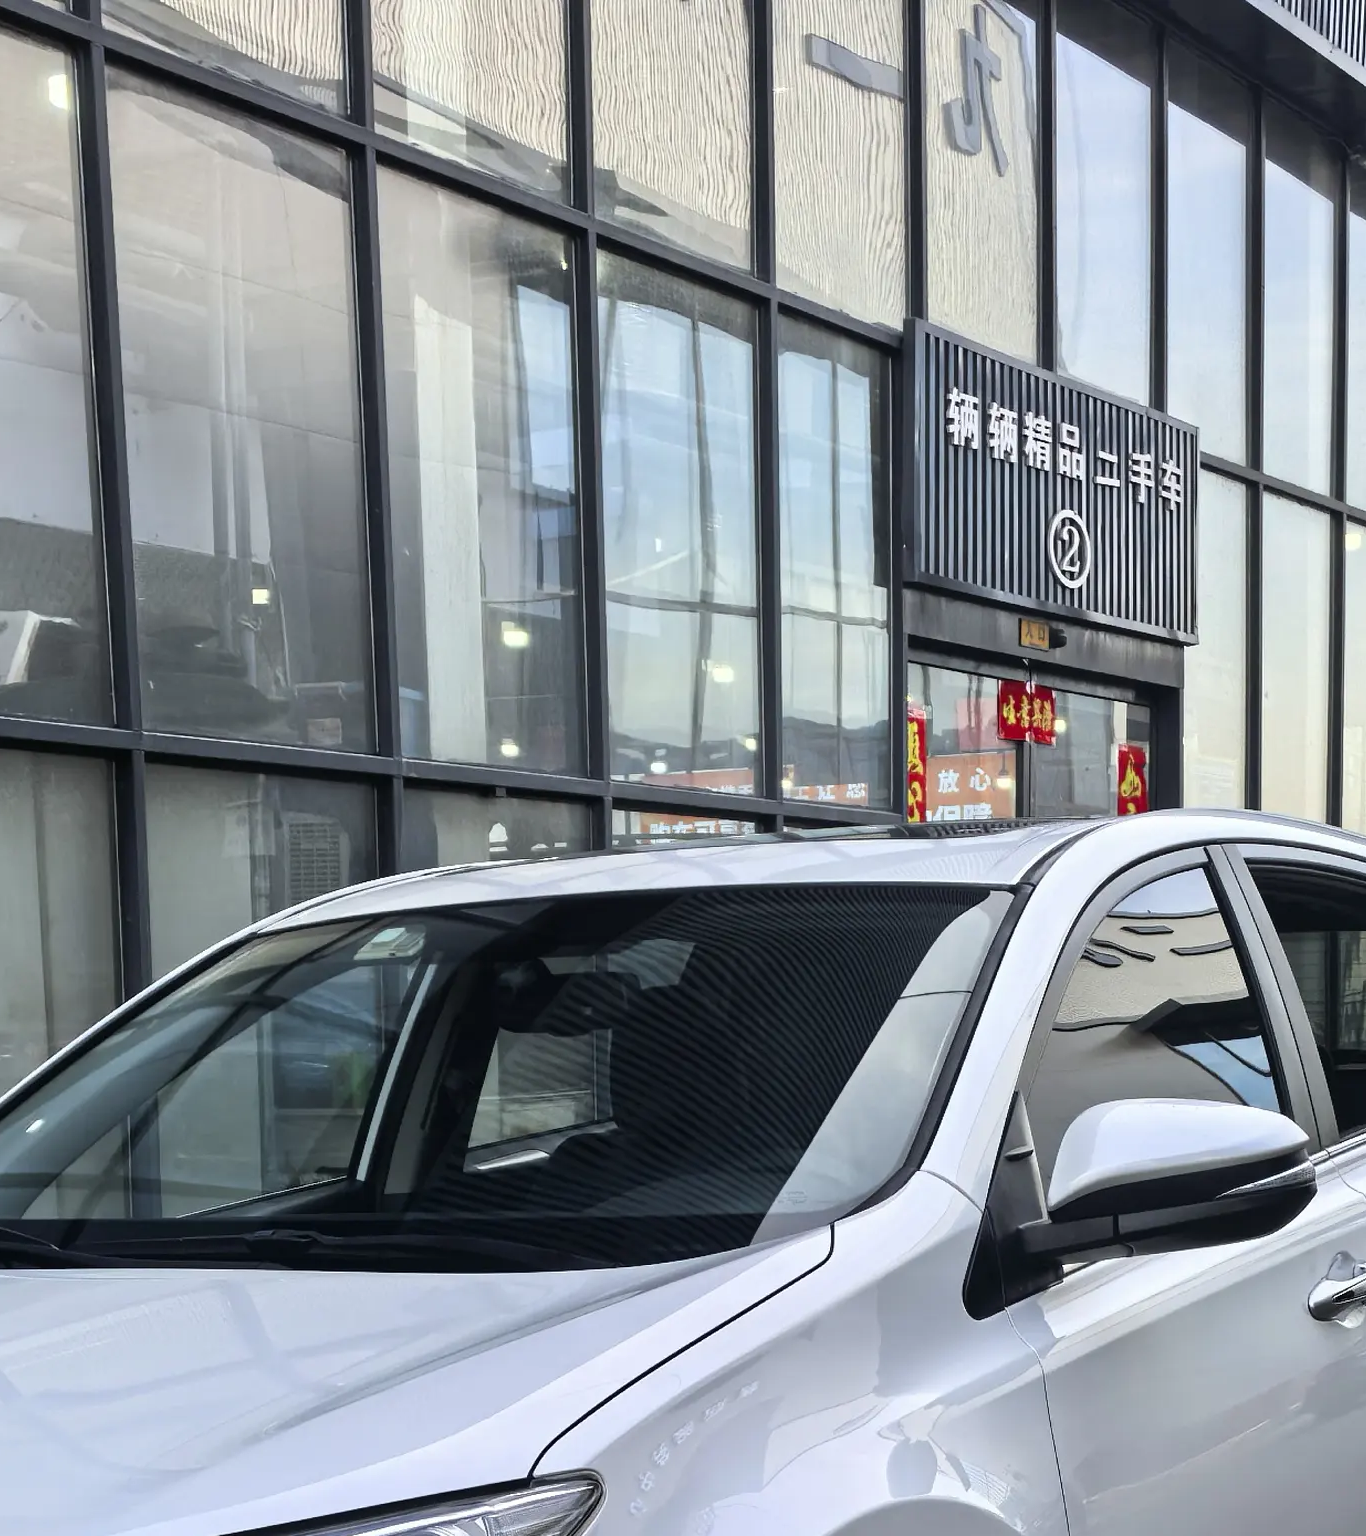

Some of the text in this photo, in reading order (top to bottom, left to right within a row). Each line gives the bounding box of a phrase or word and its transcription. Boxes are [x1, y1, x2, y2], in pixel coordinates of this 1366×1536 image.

[946, 387, 1183, 511] 辆辆精品二手车
[938, 767, 991, 794] 放心
